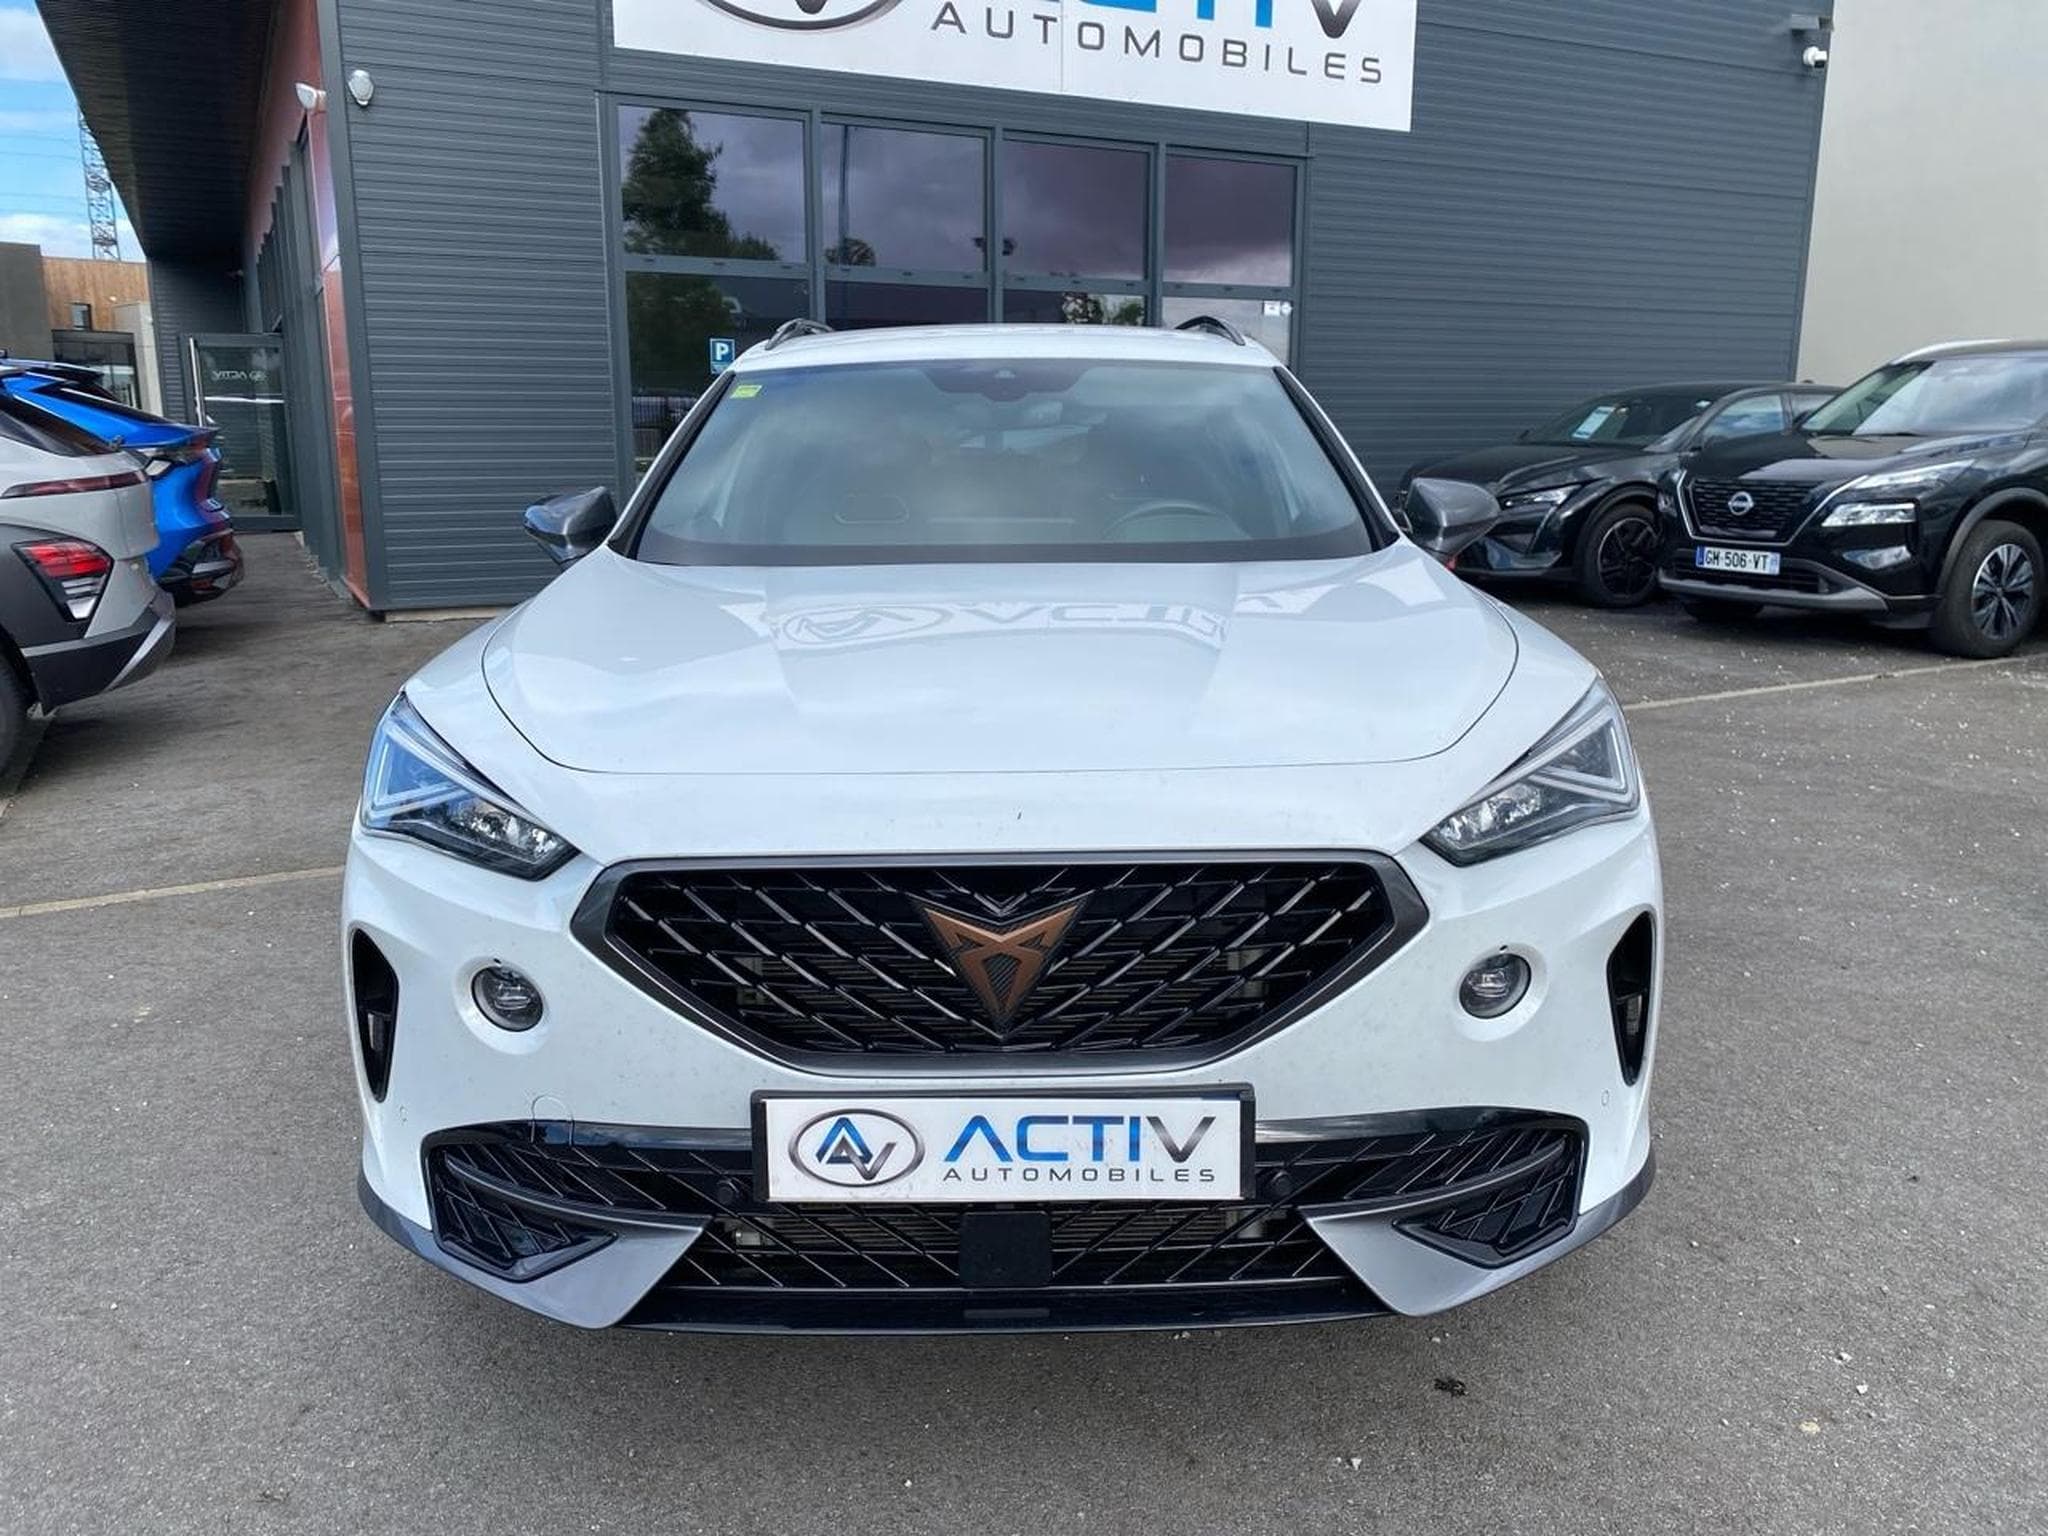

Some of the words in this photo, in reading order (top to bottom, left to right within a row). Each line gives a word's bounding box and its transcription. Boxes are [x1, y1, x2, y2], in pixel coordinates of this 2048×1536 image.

[931, 1, 1382, 84] AUTOMOBILES
[716, 342, 729, 360] P
[944, 1115, 1216, 1163] ACTIV
[942, 1167, 1216, 1182] AUTOMOBILES
